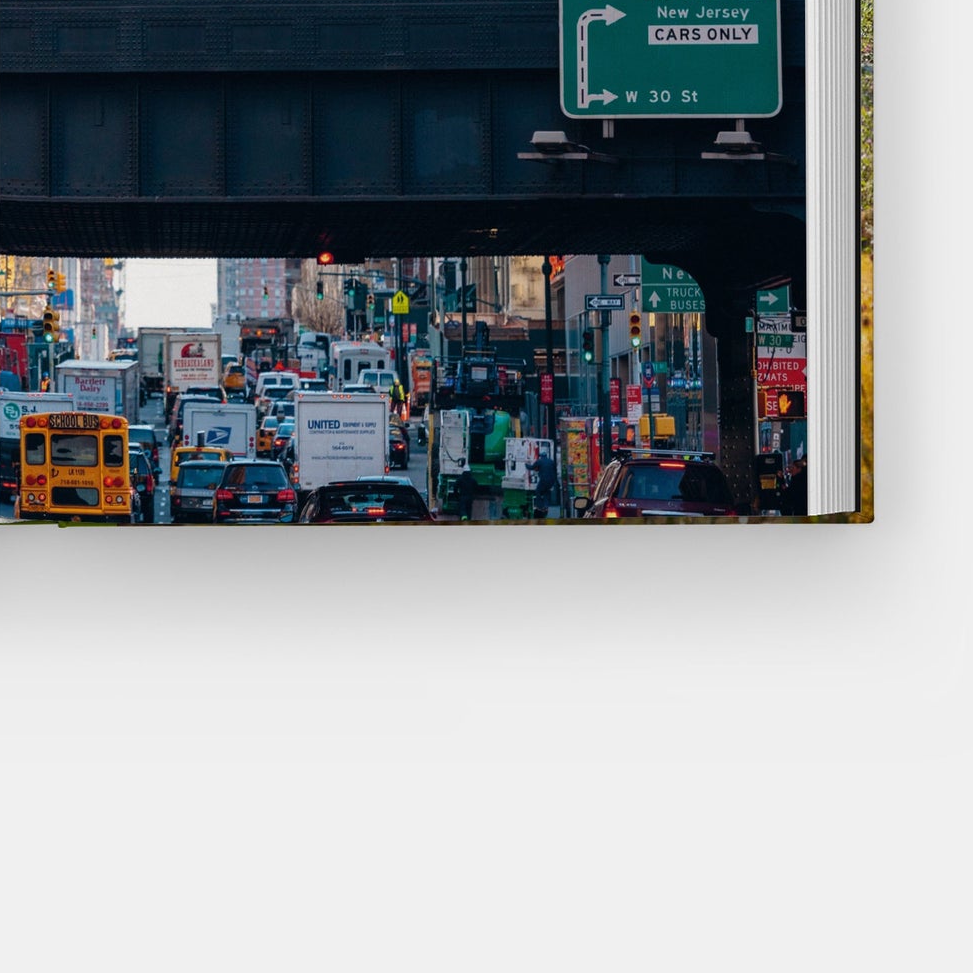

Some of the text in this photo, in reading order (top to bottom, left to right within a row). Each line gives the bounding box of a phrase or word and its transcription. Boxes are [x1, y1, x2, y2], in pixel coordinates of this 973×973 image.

[657, 5, 749, 21] New Jersey
[655, 27, 752, 41] CARS ONLY
[625, 90, 698, 103] W 30 St
[670, 300, 706, 310] BUSES
[758, 335, 766, 345] W
[769, 335, 782, 346] 30
[75, 377, 106, 385] Bartlett
[757, 373, 788, 382] ZMATS
[80, 384, 101, 395] Dairy
[49, 414, 99, 428] SCHOOL BUS
[307, 419, 340, 429] UNITED
